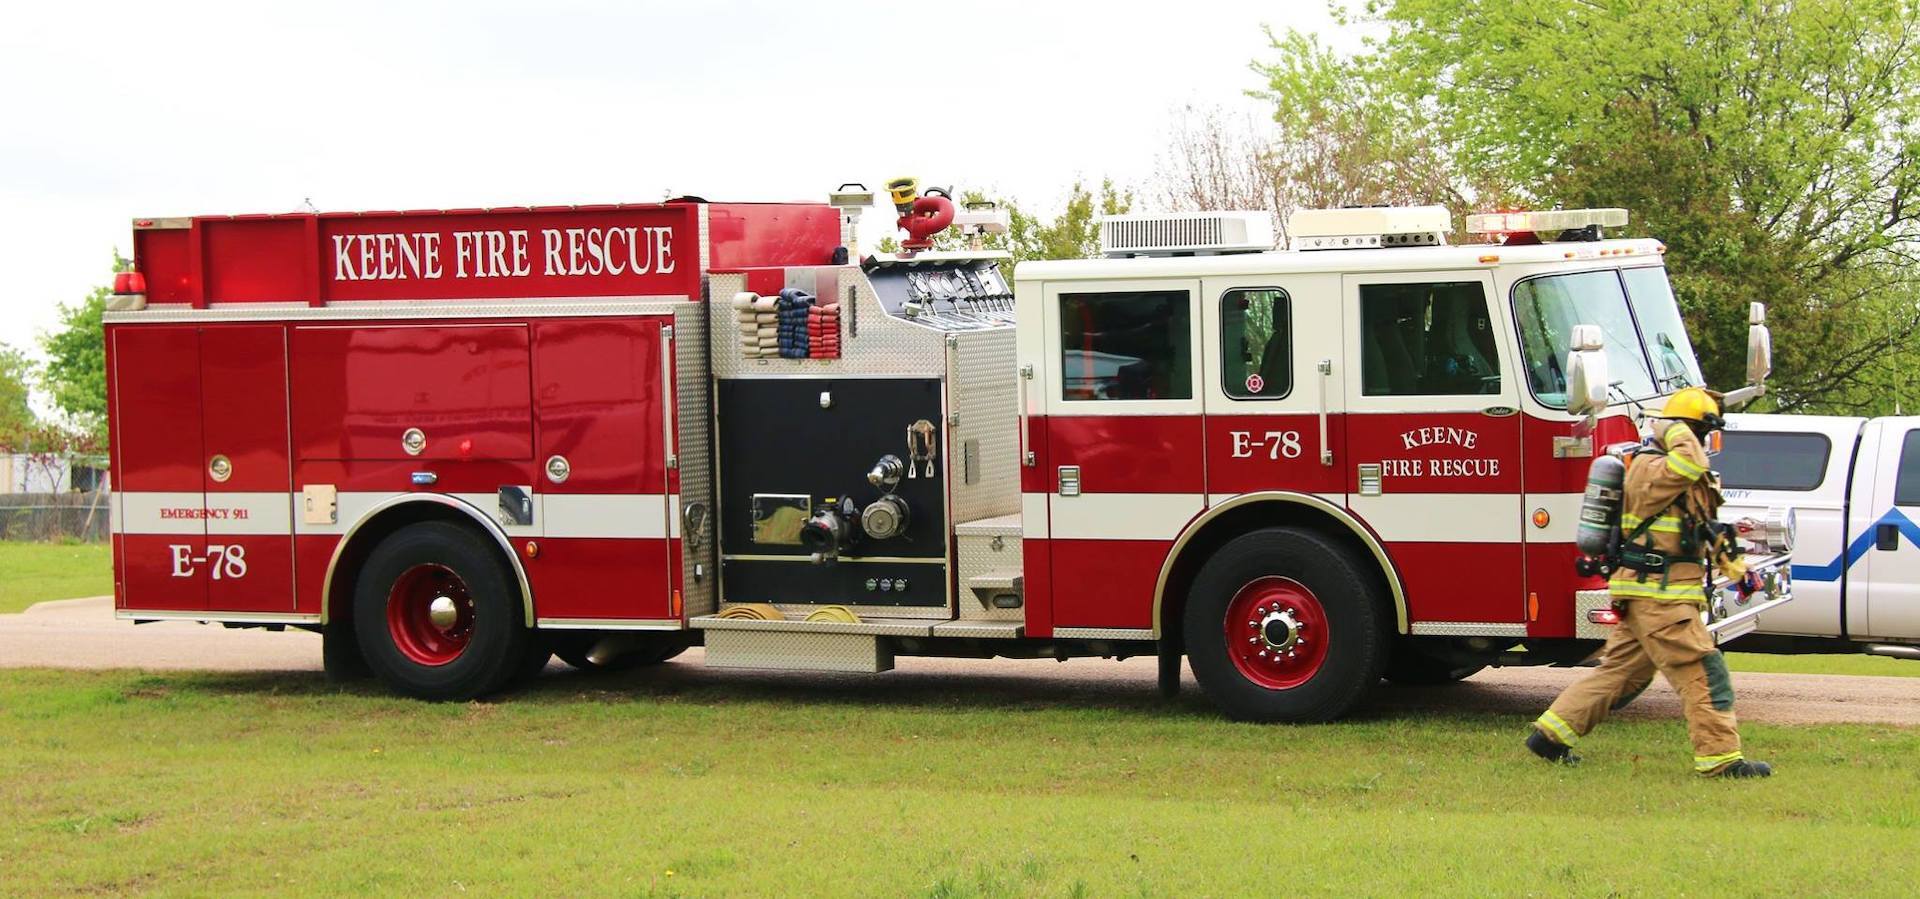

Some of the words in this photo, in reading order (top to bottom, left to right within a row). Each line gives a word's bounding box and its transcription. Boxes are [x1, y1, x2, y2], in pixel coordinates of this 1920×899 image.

[332, 232, 443, 281] KEENE
[453, 229, 531, 279] FIRE
[541, 226, 675, 276] RESCUE
[1229, 430, 1302, 460] E-78
[1400, 426, 1478, 450] KEENE
[1382, 459, 1423, 477] FIRE
[1429, 459, 1500, 477] RESCUE
[160, 508, 229, 520] EMERGENCY
[233, 508, 248, 519] 911
[169, 544, 247, 580] E-78
